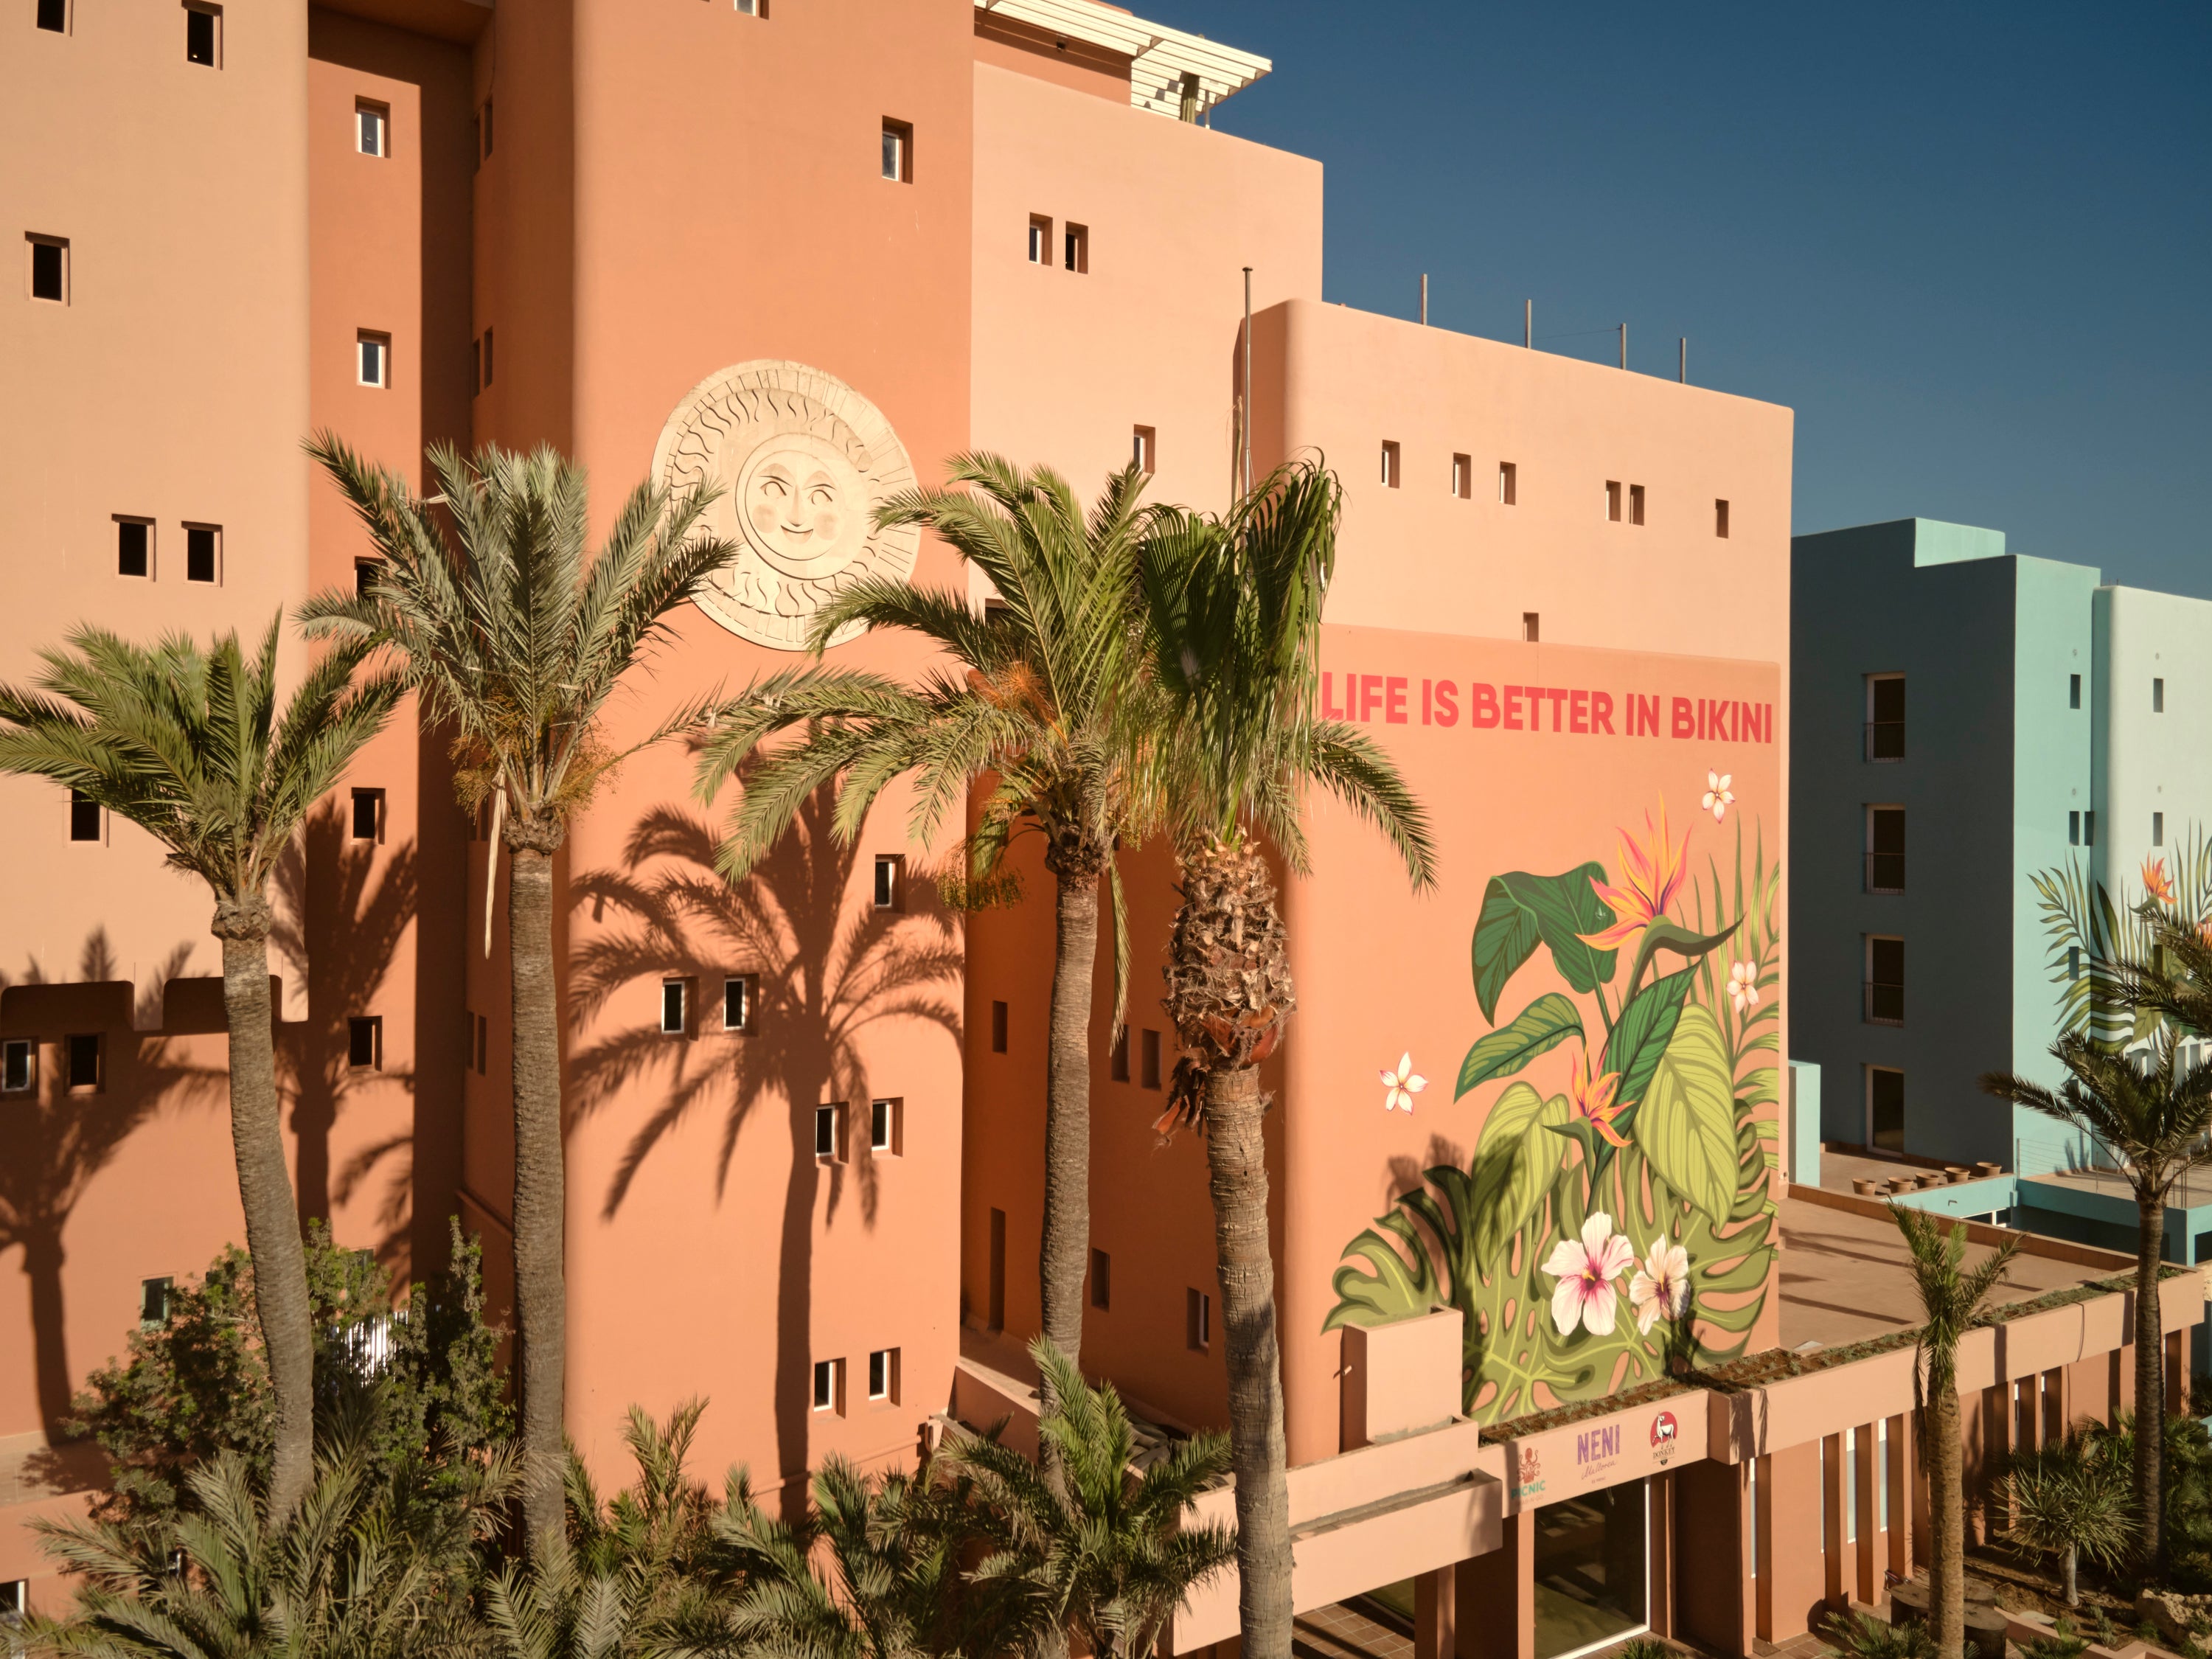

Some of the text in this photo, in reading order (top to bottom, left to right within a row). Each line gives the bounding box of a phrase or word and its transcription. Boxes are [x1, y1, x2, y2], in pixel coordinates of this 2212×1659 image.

[1321, 672, 1772, 744] LIFE IS BETTER IN BIKINI
[1578, 1424, 1620, 1465] NENI
[1652, 1447, 1675, 1459] DONKEY
[1581, 1460, 1617, 1480] Mallorca
[1511, 1479, 1546, 1499] PICNIC
